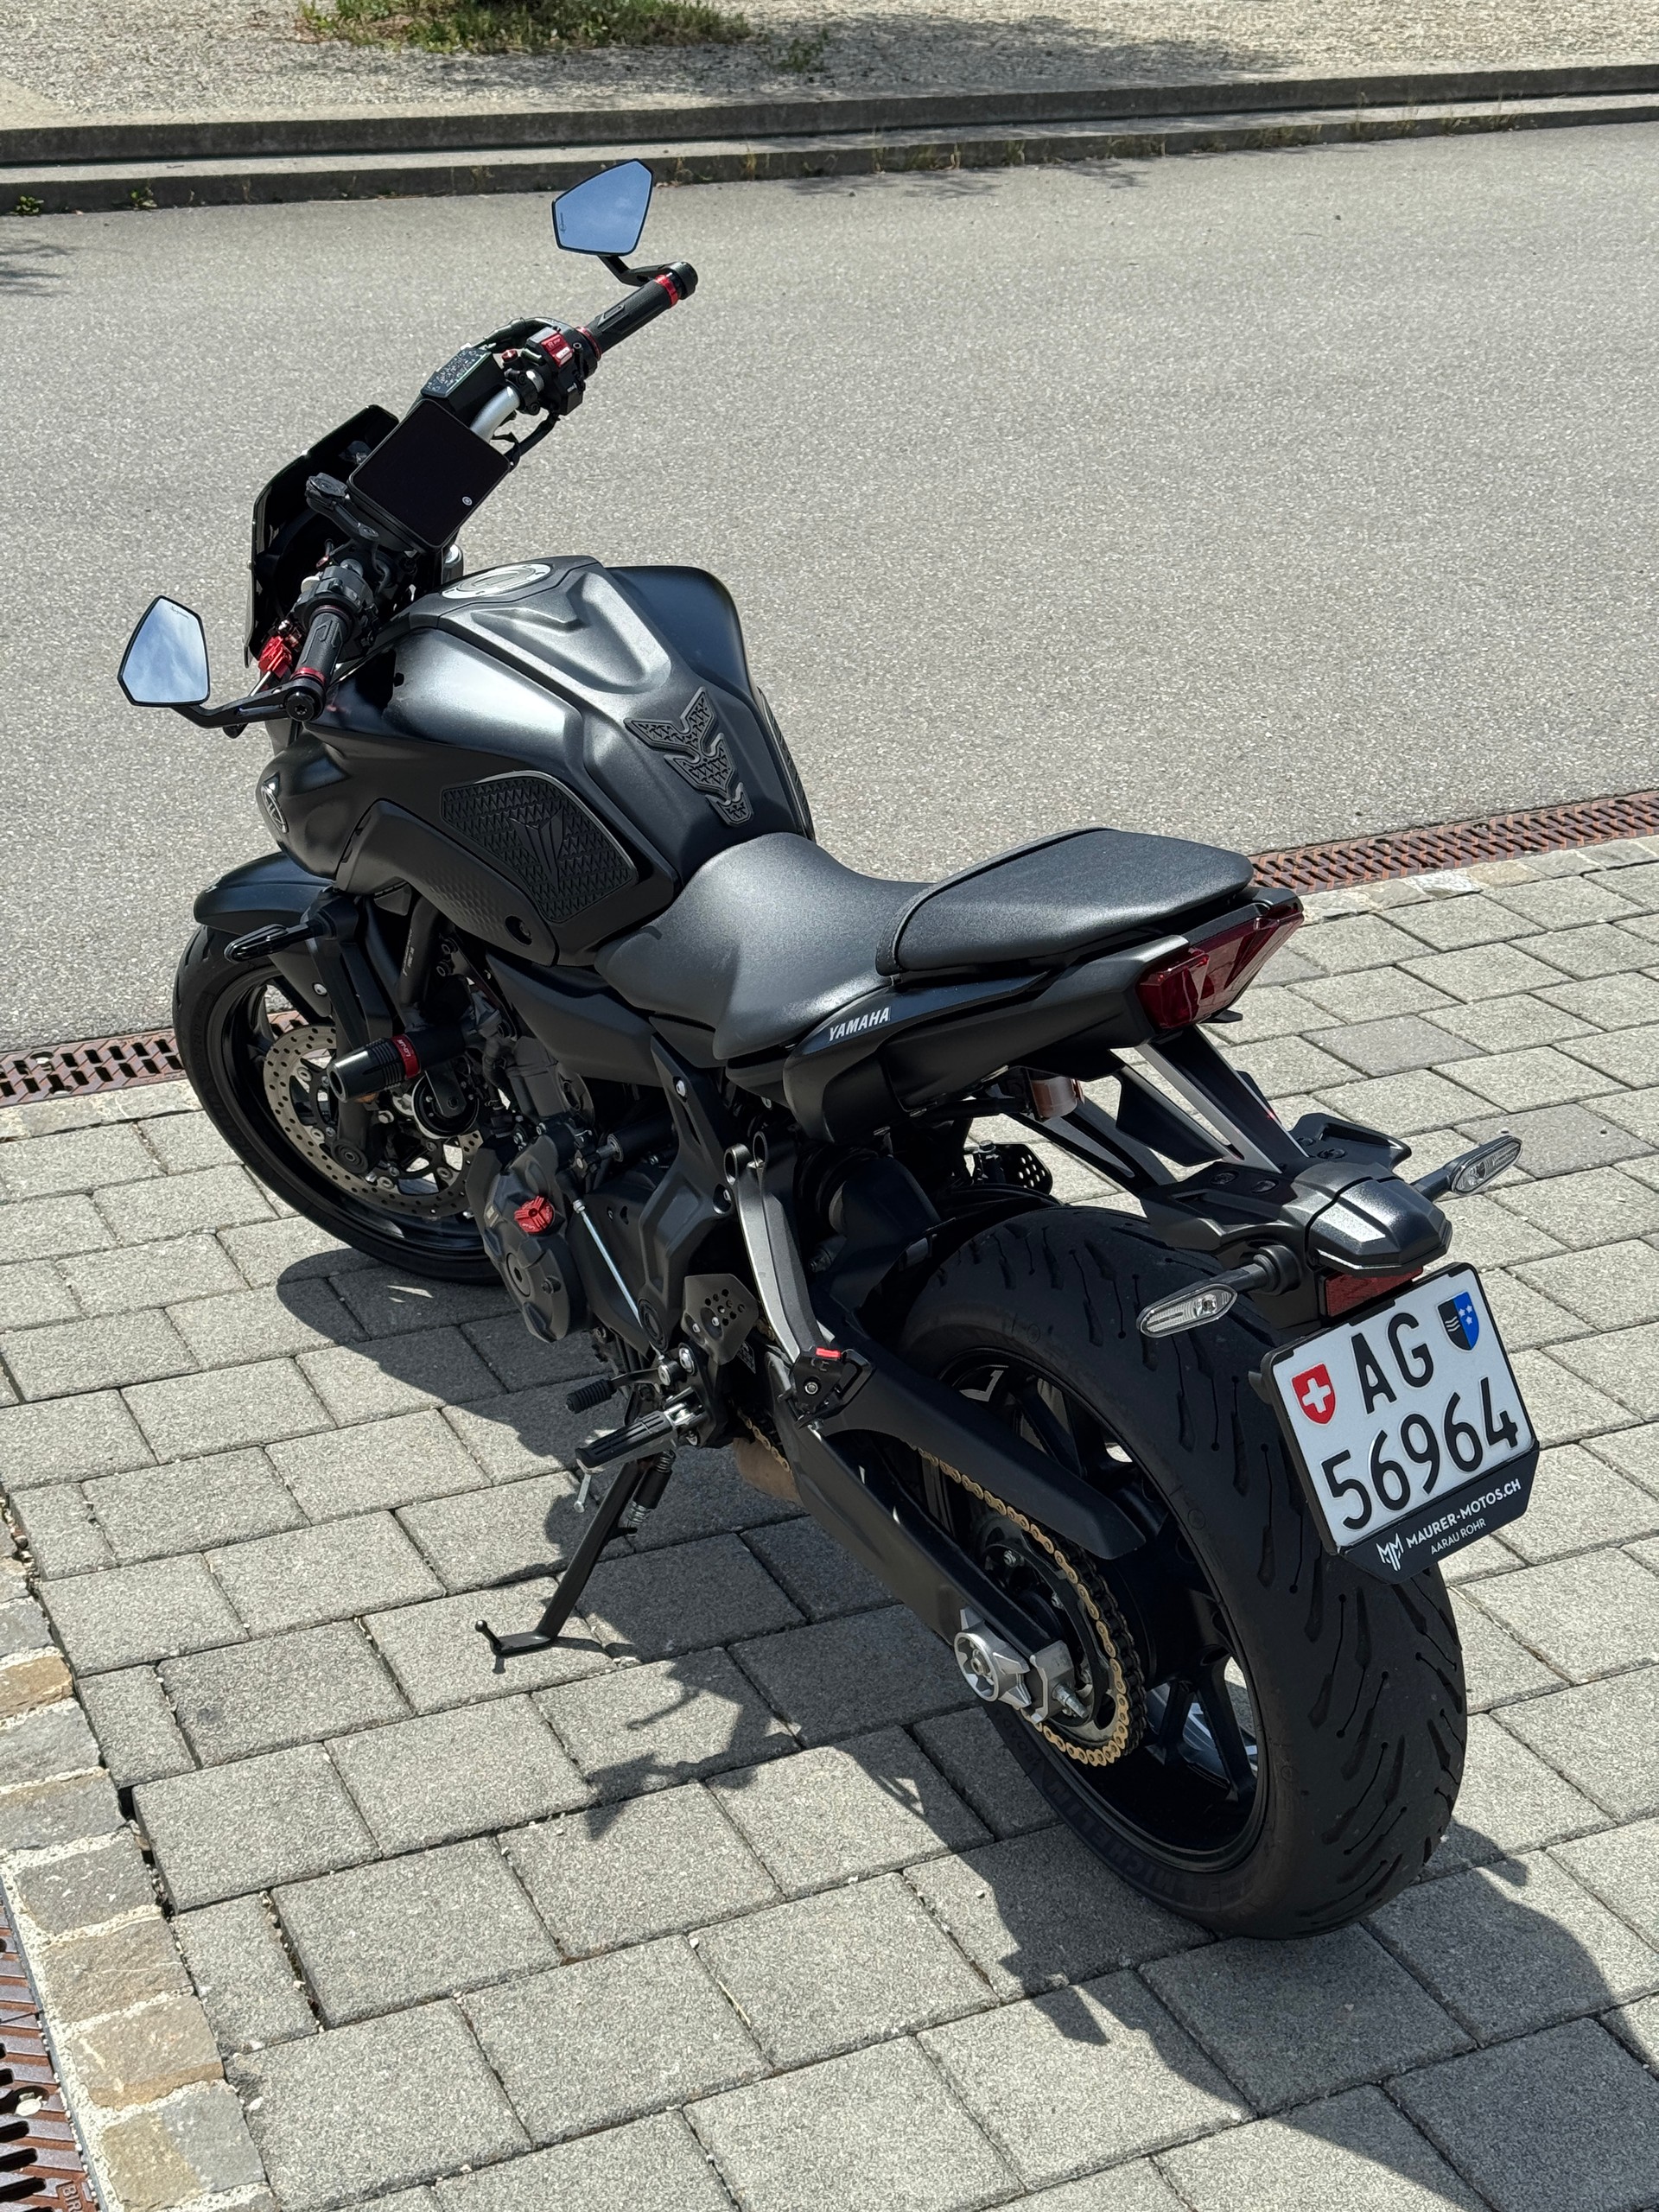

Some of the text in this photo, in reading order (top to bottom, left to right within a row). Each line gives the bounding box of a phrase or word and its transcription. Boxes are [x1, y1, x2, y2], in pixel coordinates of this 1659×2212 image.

[829, 1007, 890, 1042] YAMAHA
[1351, 1312, 1434, 1414] AG
[1321, 1376, 1518, 1529] 56964
[1406, 1478, 1522, 1548] MAURER-MOTOS.CH
[1431, 1518, 1486, 1554] AARAU ROHR
[1046, 1780, 1178, 1895] MICHELIN
